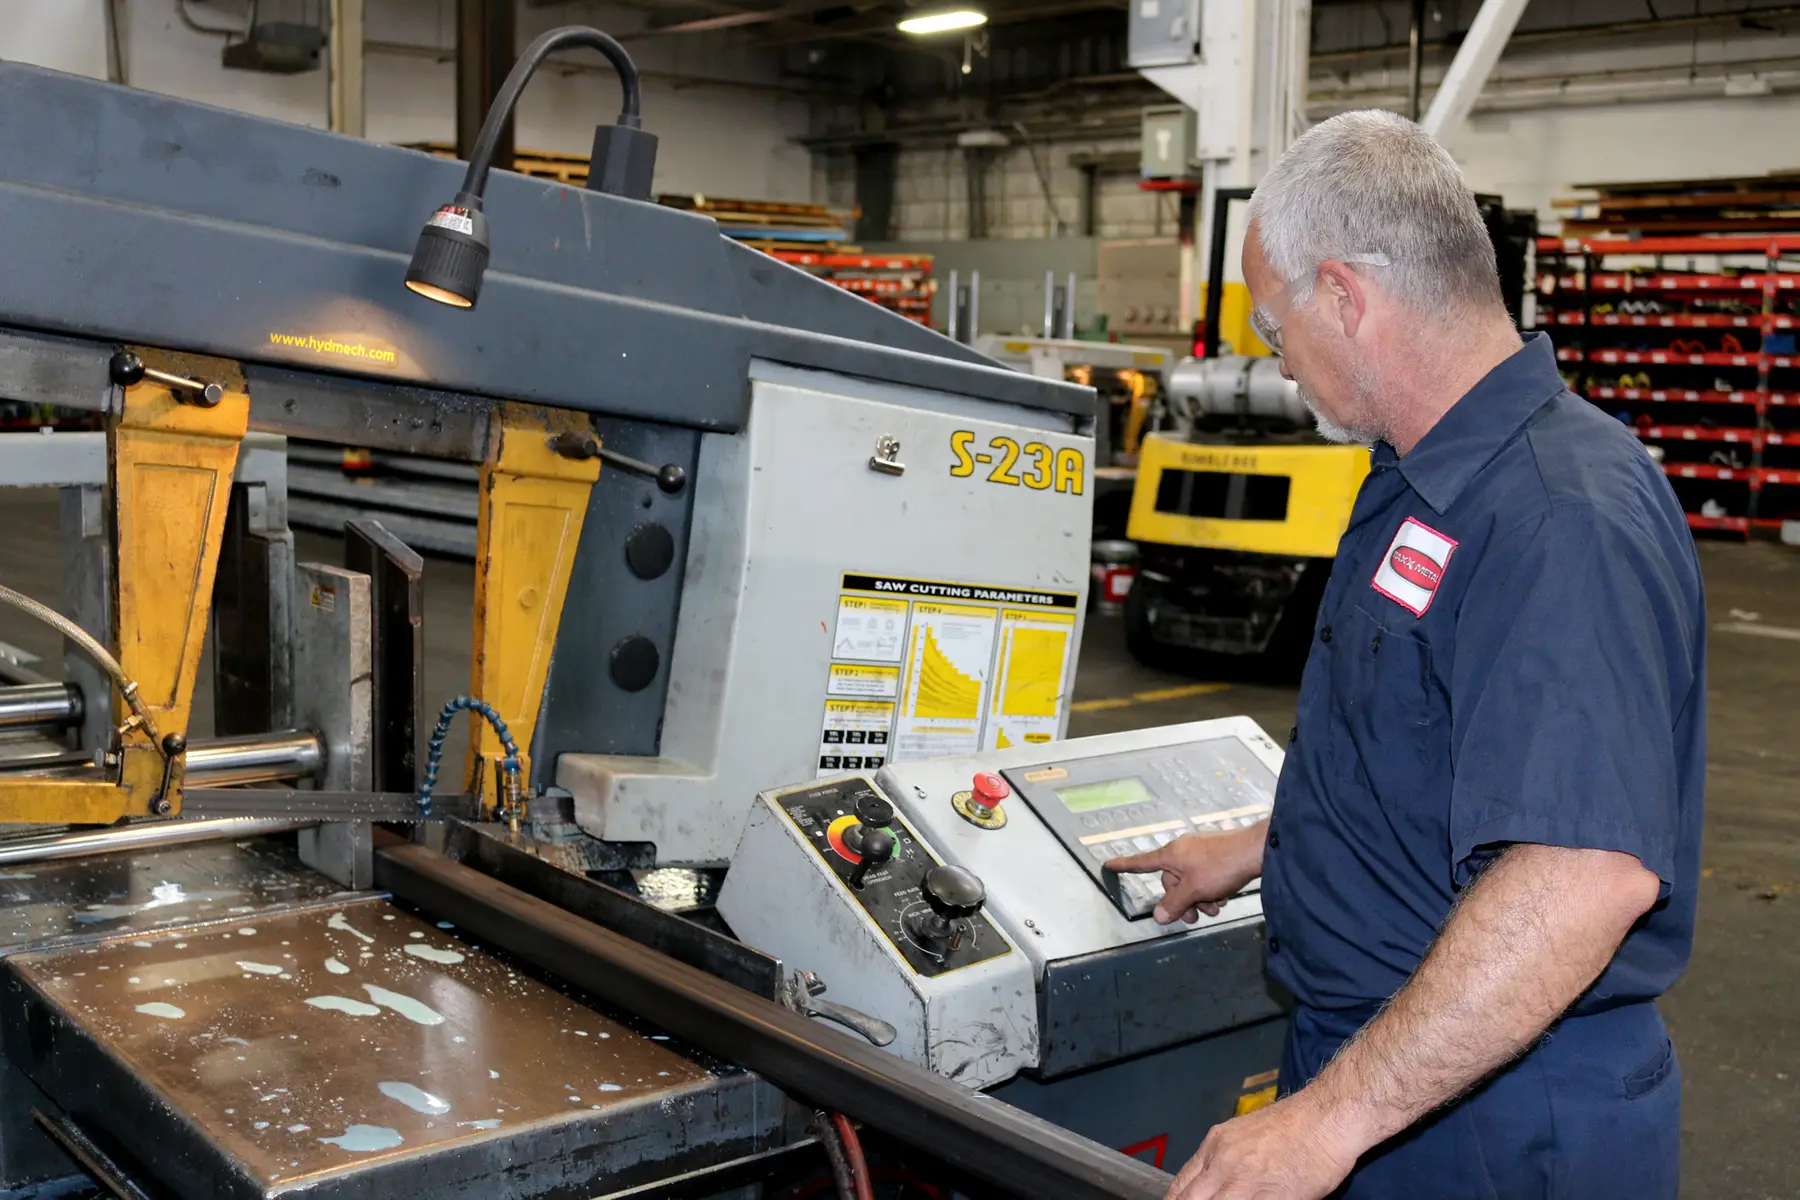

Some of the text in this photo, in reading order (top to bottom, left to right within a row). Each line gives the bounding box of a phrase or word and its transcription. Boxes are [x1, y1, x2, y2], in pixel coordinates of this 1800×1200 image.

[270, 332, 395, 361] www.hydmech.com
[950, 430, 1084, 496] S-23A
[875, 581, 1054, 605] SAW CUTTING PARAMETERS
